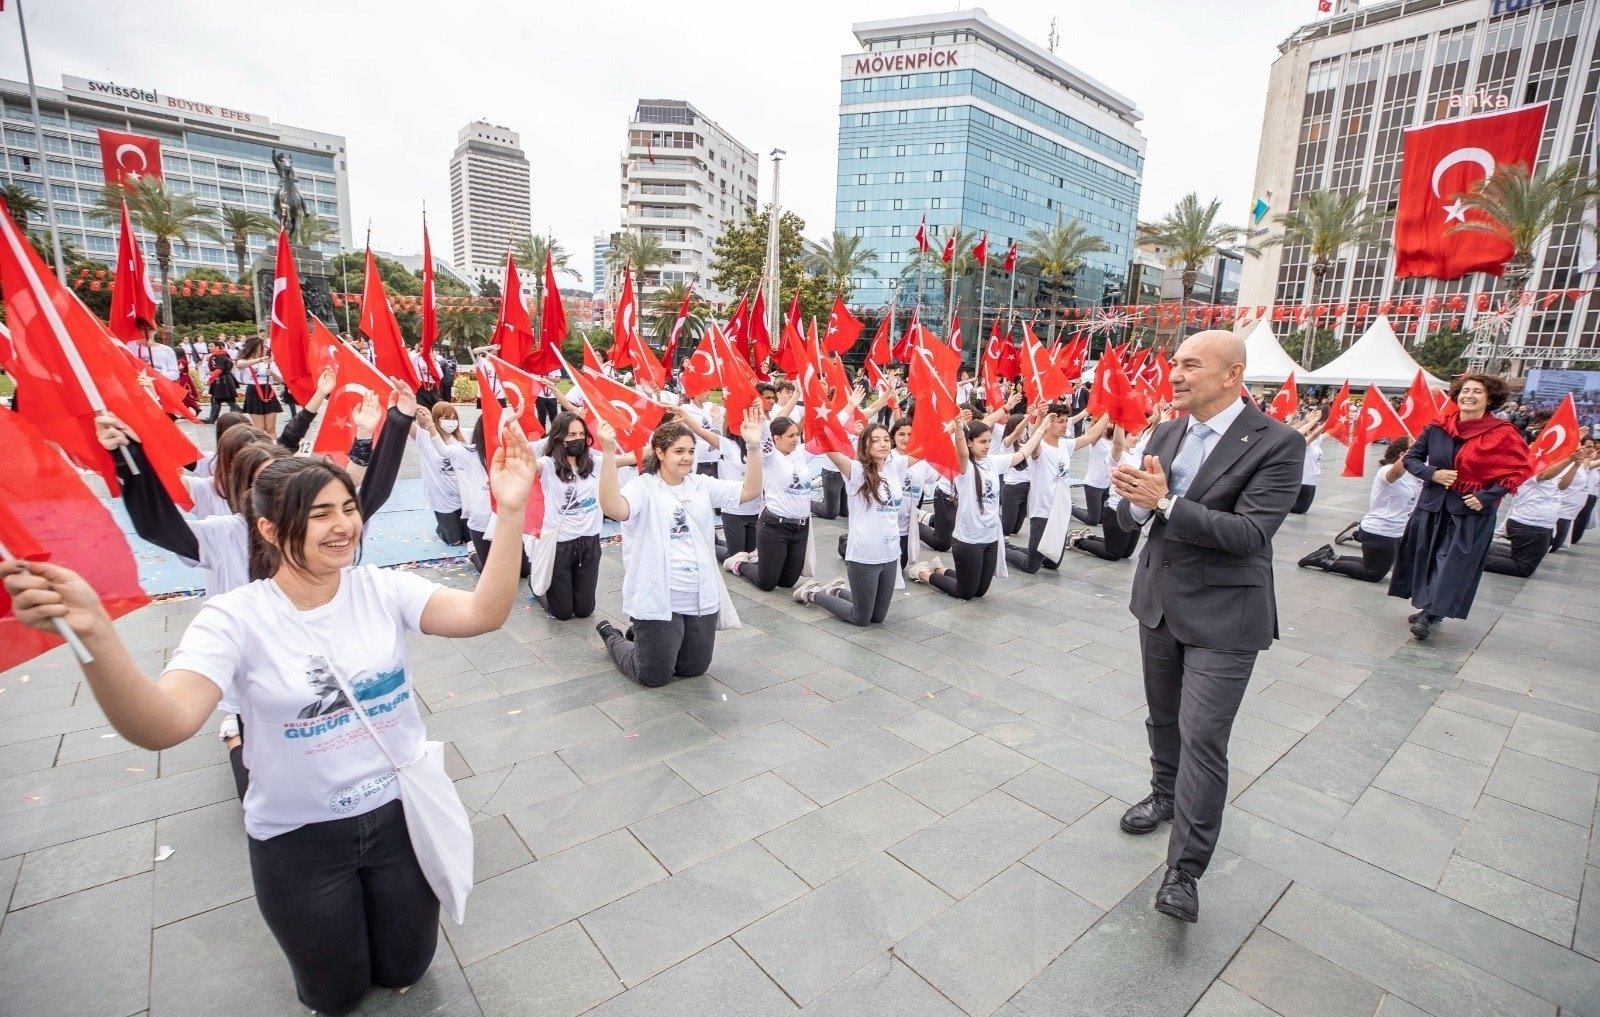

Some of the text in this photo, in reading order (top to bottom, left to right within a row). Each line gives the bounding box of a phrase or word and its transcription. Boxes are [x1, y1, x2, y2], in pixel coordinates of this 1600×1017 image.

[88, 81, 251, 123] swissôtel BÜYÜK EFES
[284, 713, 351, 740] GURUR
